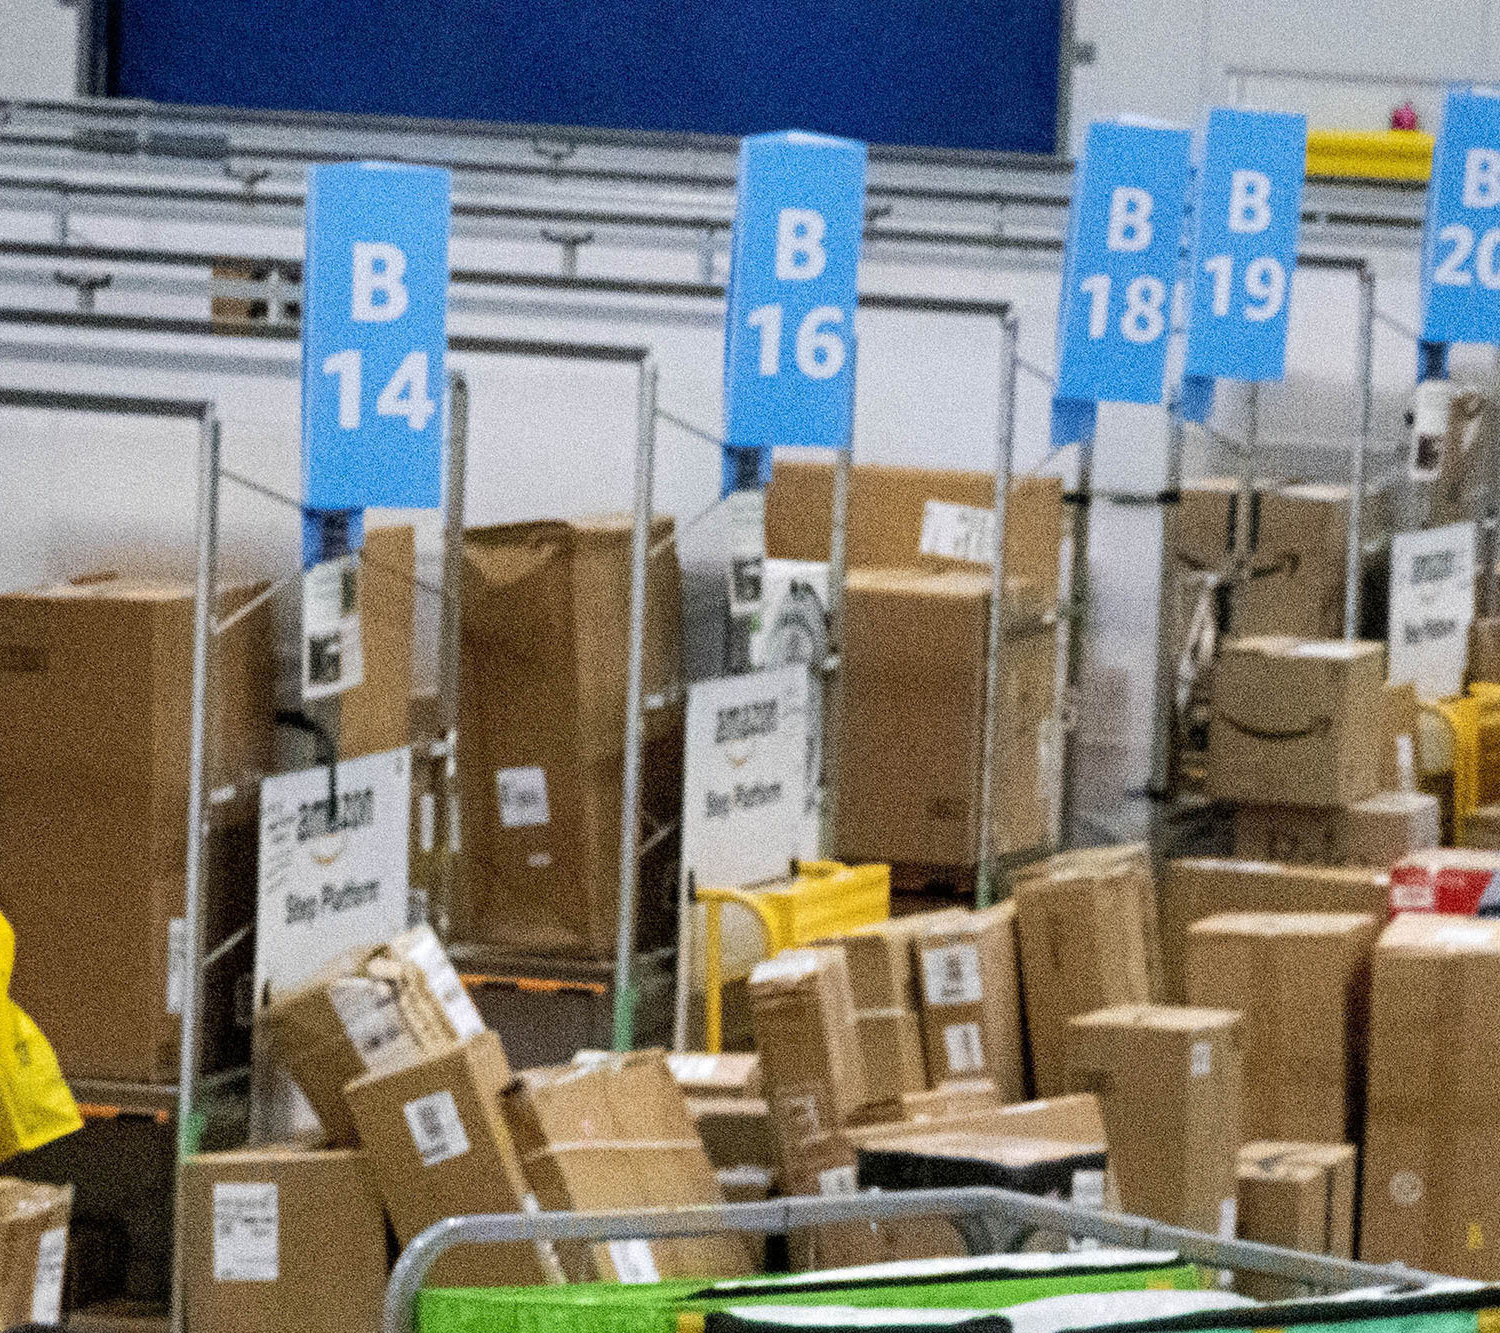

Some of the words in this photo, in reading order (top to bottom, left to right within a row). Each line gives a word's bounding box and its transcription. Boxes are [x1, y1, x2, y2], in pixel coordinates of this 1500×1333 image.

[1107, 187, 1153, 252] B
[1228, 170, 1271, 233] B
[776, 209, 825, 280] B
[351, 243, 407, 321] B
[1081, 275, 1165, 342] 18
[1204, 255, 1285, 322] 19
[748, 305, 846, 378] 16
[322, 351, 435, 429] 14
